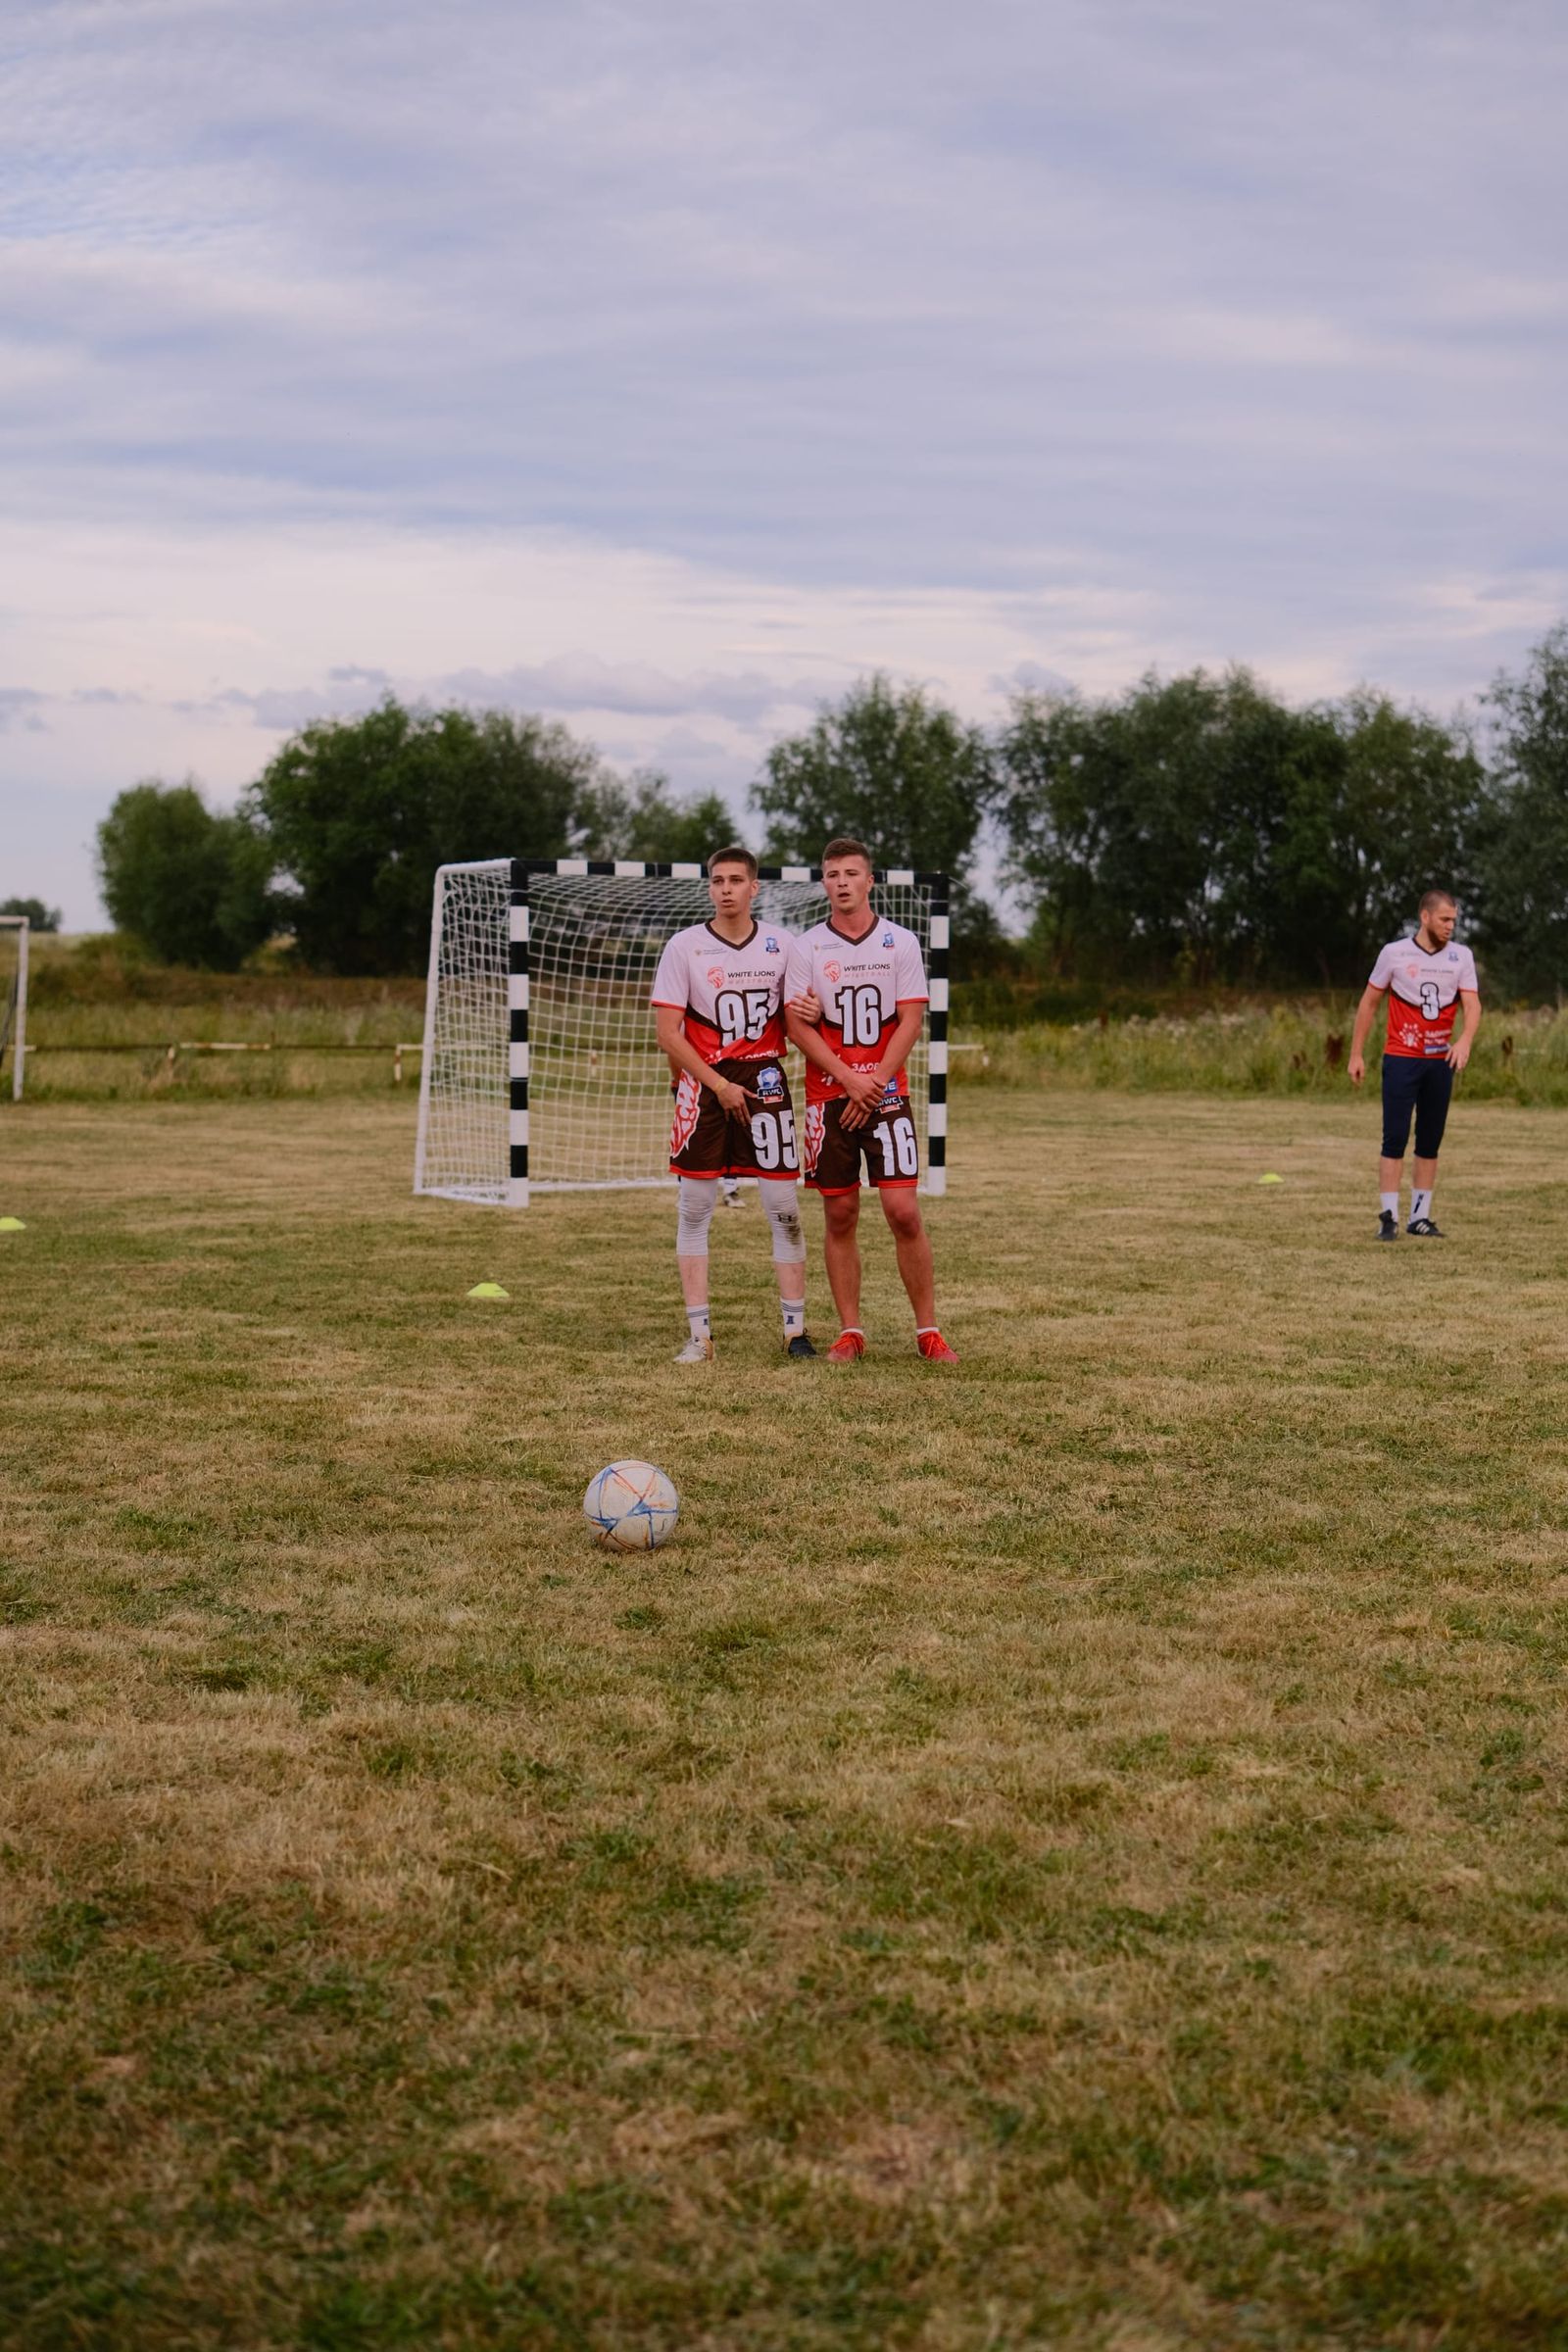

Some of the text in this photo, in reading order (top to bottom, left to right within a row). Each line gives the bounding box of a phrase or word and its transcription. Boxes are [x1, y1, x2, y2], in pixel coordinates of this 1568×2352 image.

[715, 988, 770, 1049] 95
[835, 984, 881, 1048] 16
[1420, 982, 1440, 1022] 3
[751, 1110, 799, 1170] 95
[874, 1117, 918, 1176] 16
